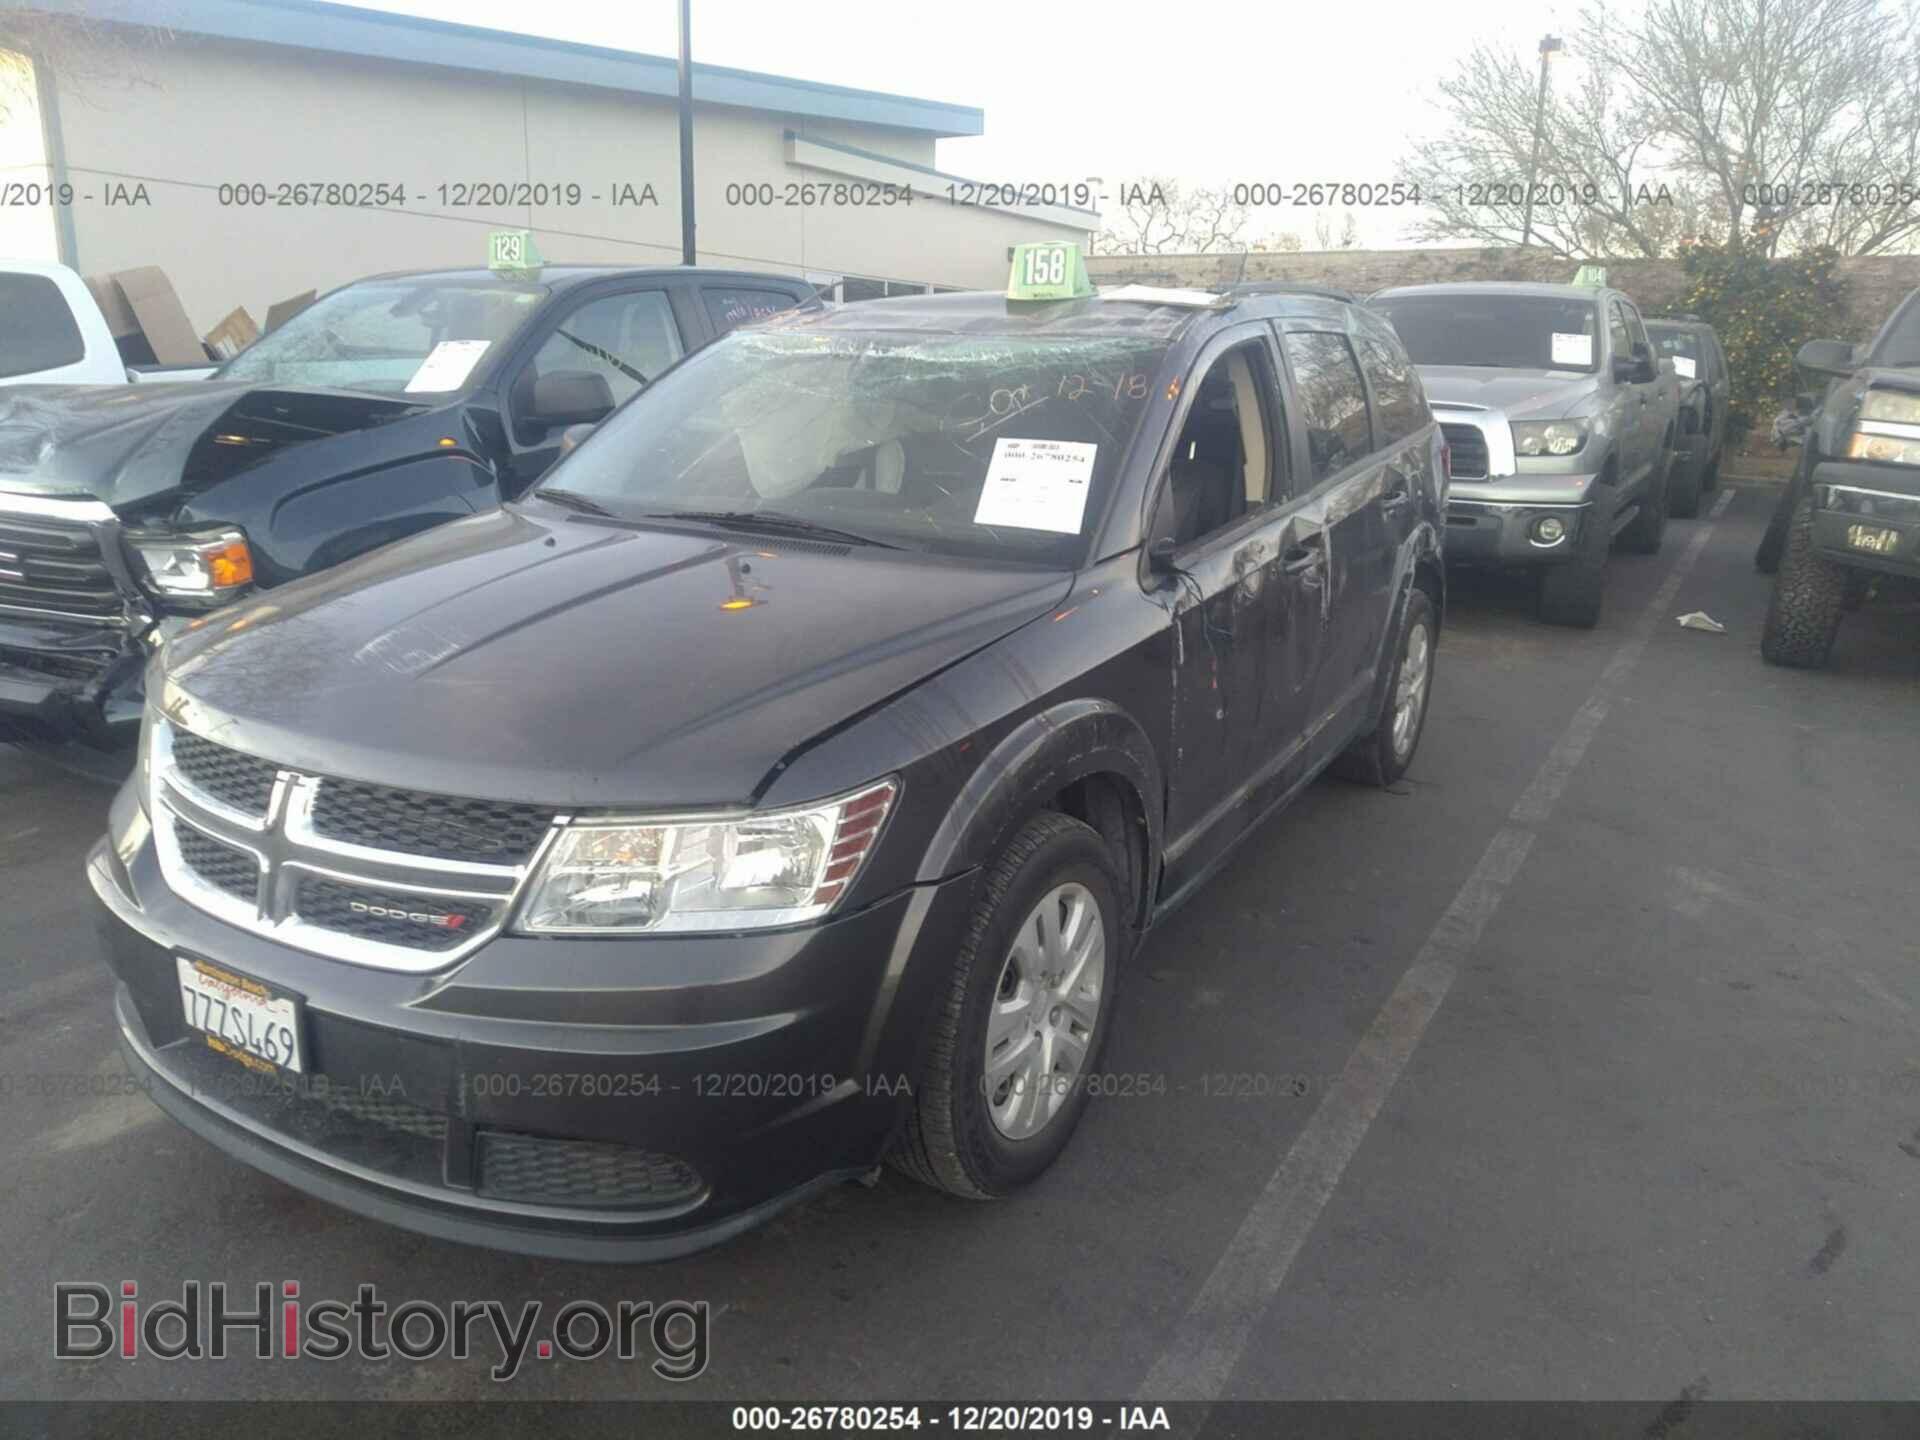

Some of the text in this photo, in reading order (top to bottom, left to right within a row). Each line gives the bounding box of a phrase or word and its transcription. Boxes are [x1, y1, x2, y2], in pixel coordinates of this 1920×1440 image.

[496, 236, 520, 260] 129
[1023, 248, 1065, 285] 158
[350, 902, 449, 925] DODGE
